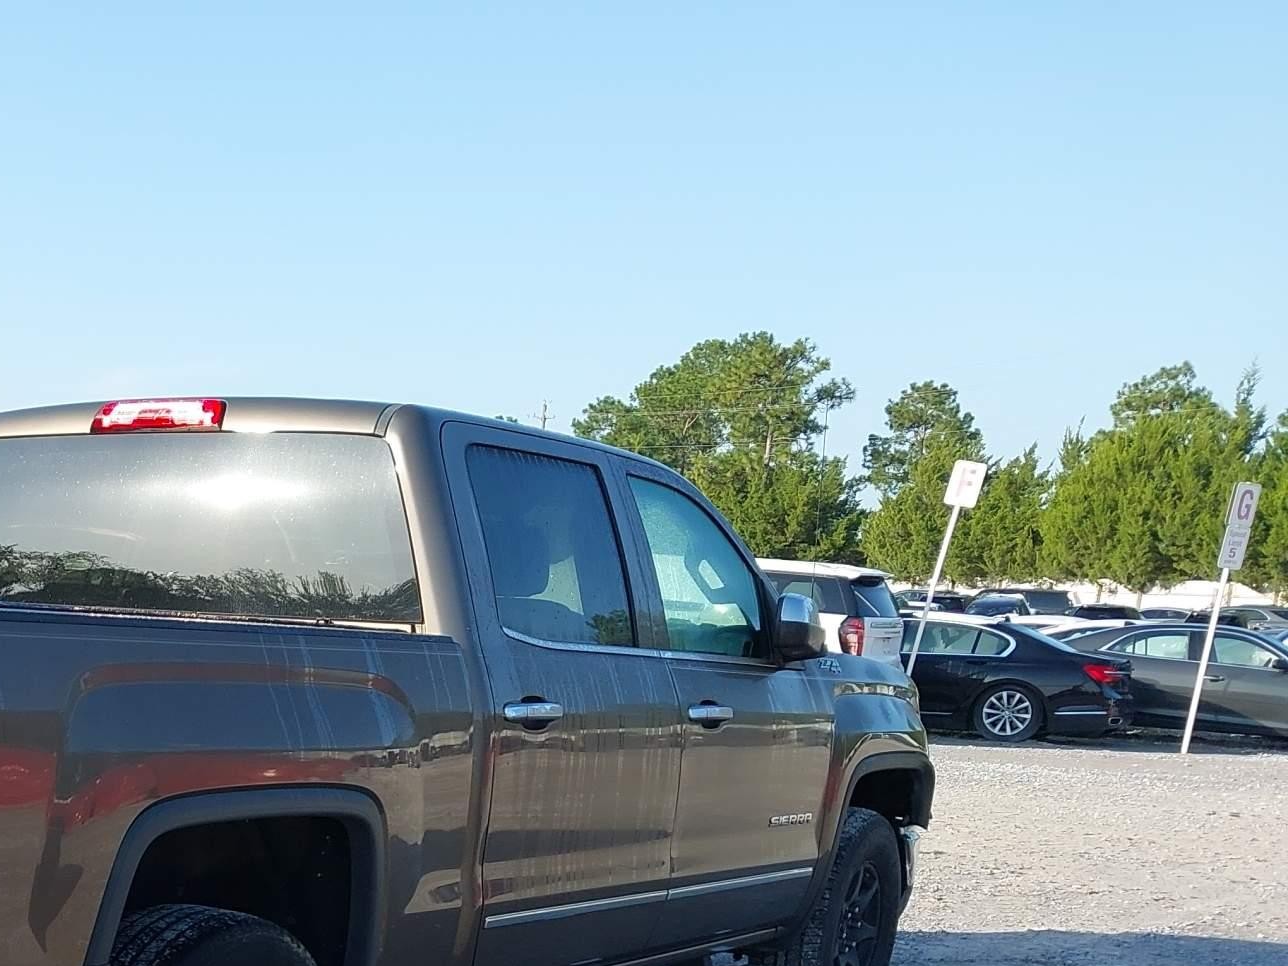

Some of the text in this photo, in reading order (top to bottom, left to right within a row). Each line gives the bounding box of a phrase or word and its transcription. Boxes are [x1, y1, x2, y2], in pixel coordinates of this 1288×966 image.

[1237, 488, 1255, 521] G
[1228, 547, 1237, 559] 5
[769, 812, 813, 826] SIERRA
